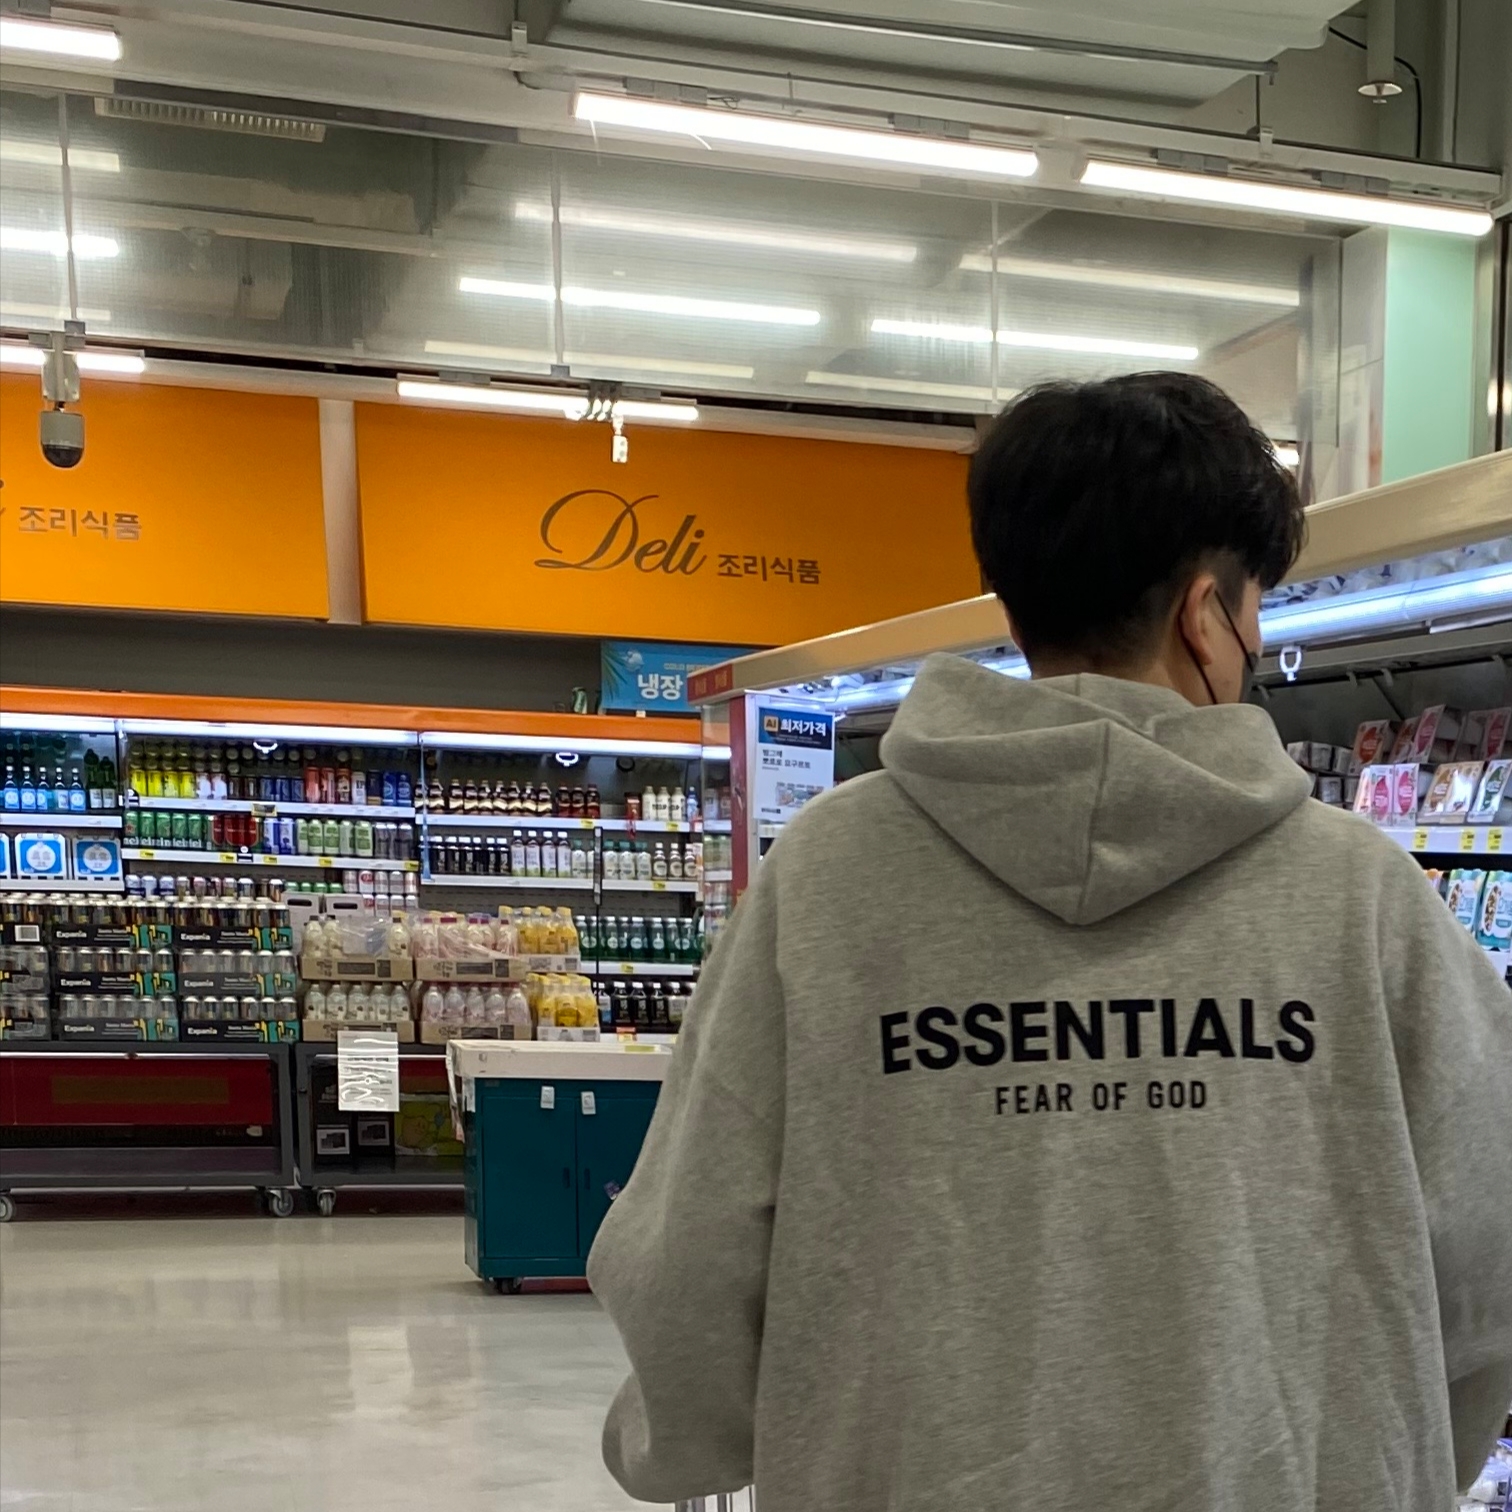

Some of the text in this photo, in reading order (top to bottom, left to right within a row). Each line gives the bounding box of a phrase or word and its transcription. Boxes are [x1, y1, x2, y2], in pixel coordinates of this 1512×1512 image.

[18, 506, 143, 541] 조리식품
[534, 489, 822, 585] Deli 조리식품
[637, 673, 684, 701] 냉장
[780, 718, 827, 737] 최저가격
[879, 997, 1317, 1075] ESSENTIALS
[995, 1080, 1208, 1115] FEAR OF GOD
